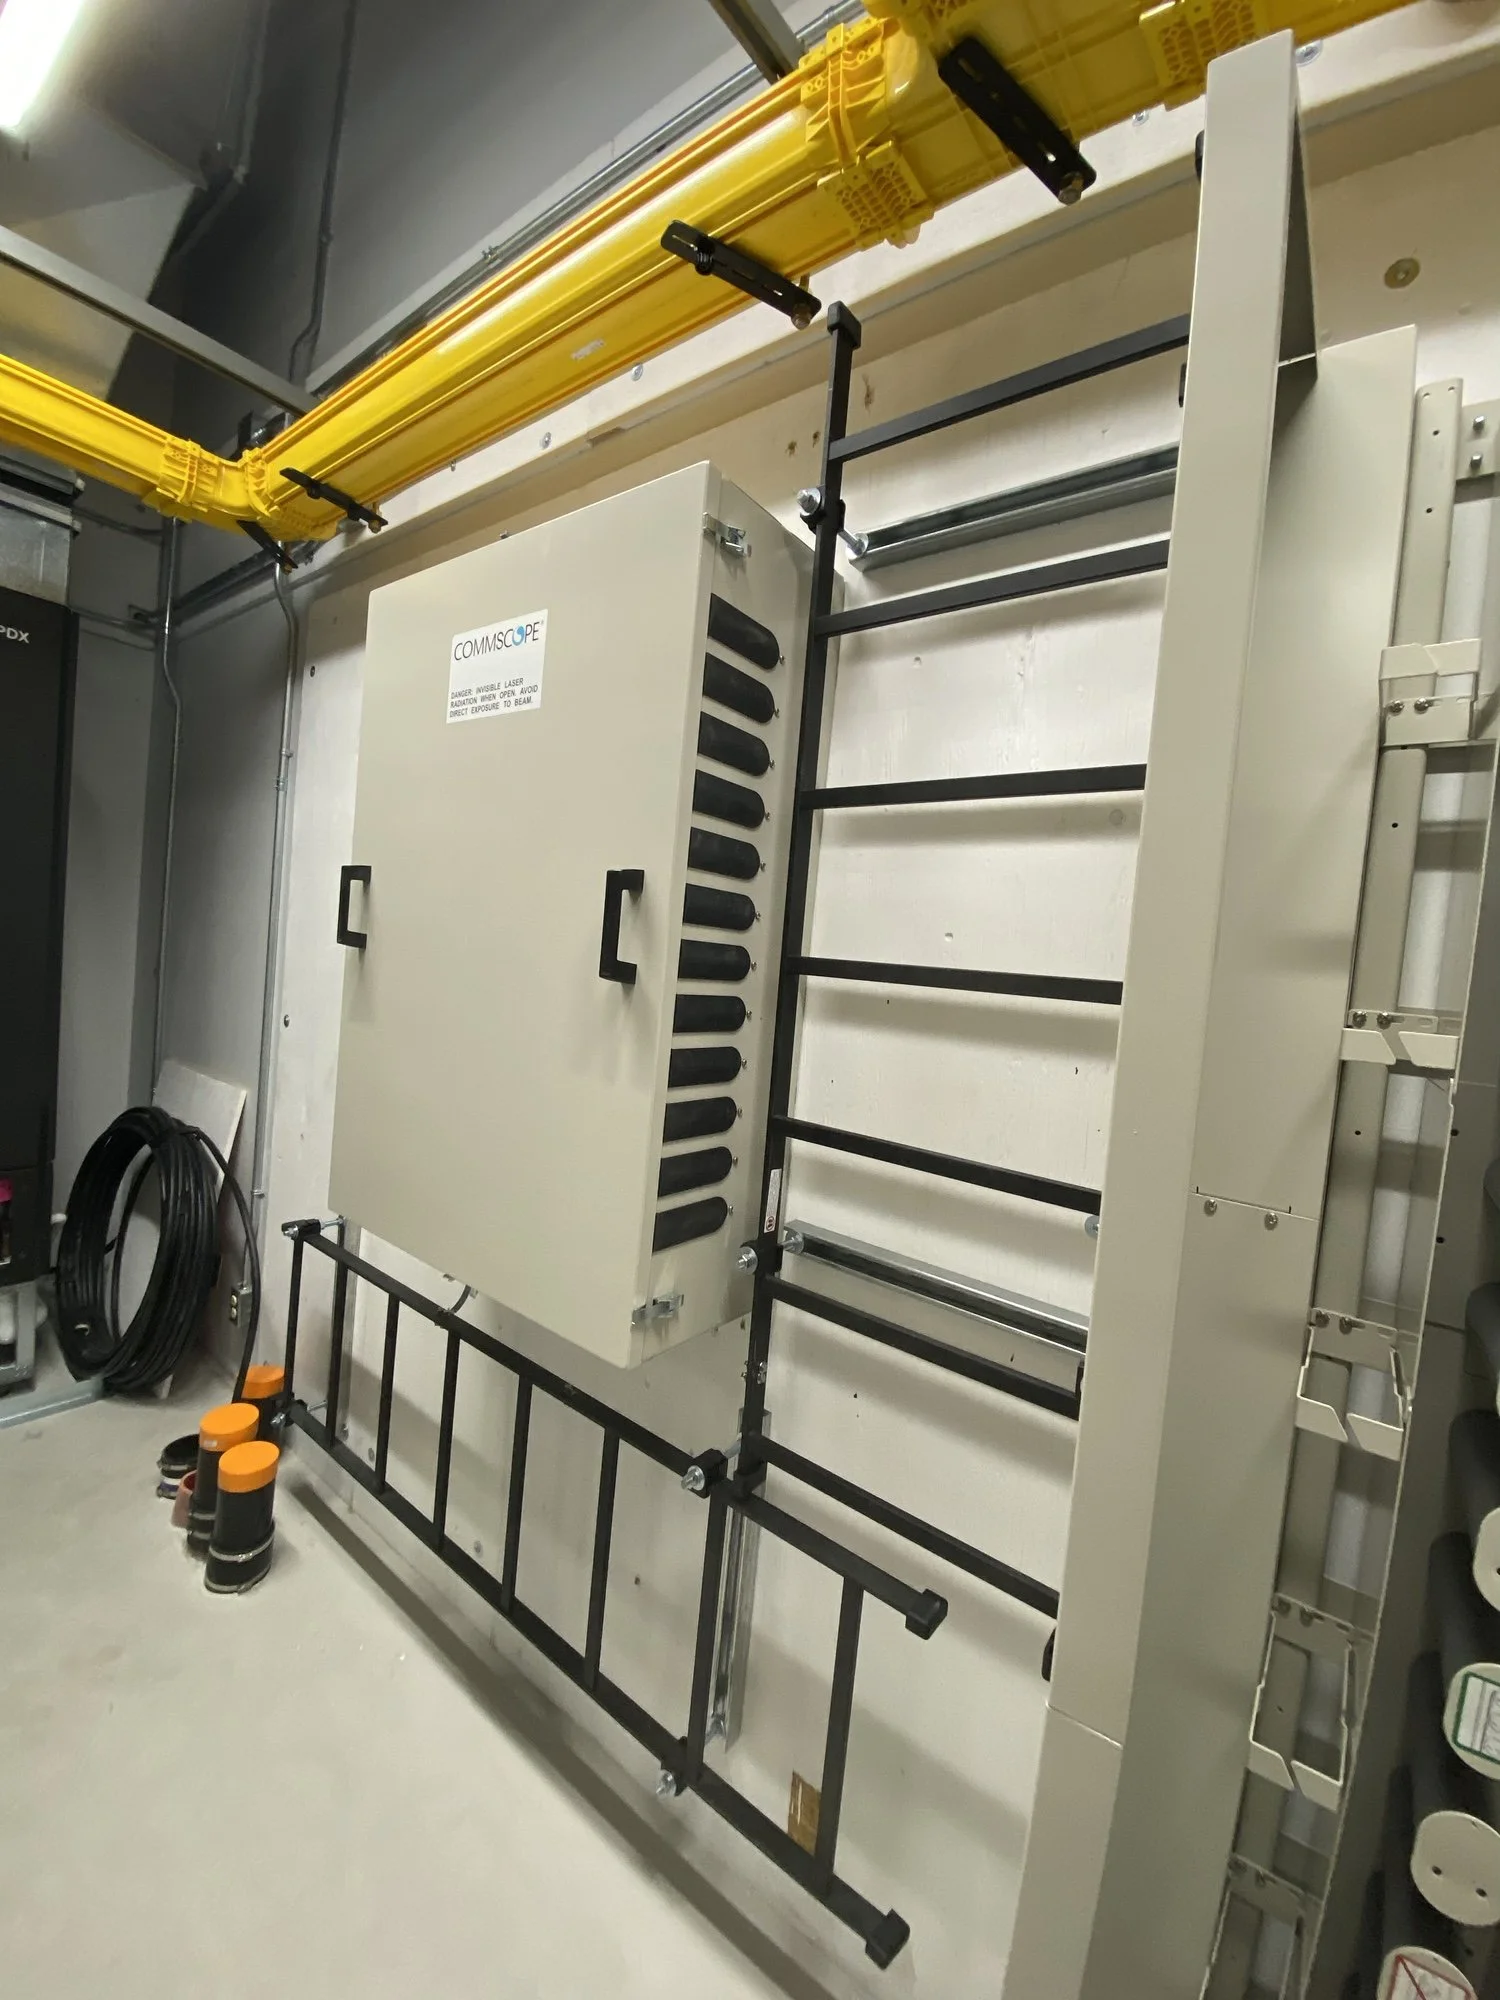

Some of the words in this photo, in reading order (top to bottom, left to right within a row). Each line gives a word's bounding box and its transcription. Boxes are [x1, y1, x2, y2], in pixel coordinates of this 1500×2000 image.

[454, 622, 540, 661] COMMSCOPE
[450, 697, 478, 708] RADIATION
[480, 693, 496, 703] WHEN
[520, 684, 538, 695] AVOID
[451, 688, 473, 699] DANGER:
[476, 682, 501, 694] INVISIBLE
[504, 677, 524, 689] LASER
[450, 708, 469, 718] DIRECT
[471, 702, 500, 714] EXPOSURE
[504, 700, 512, 708] TO
[514, 696, 534, 707] BEAM.
